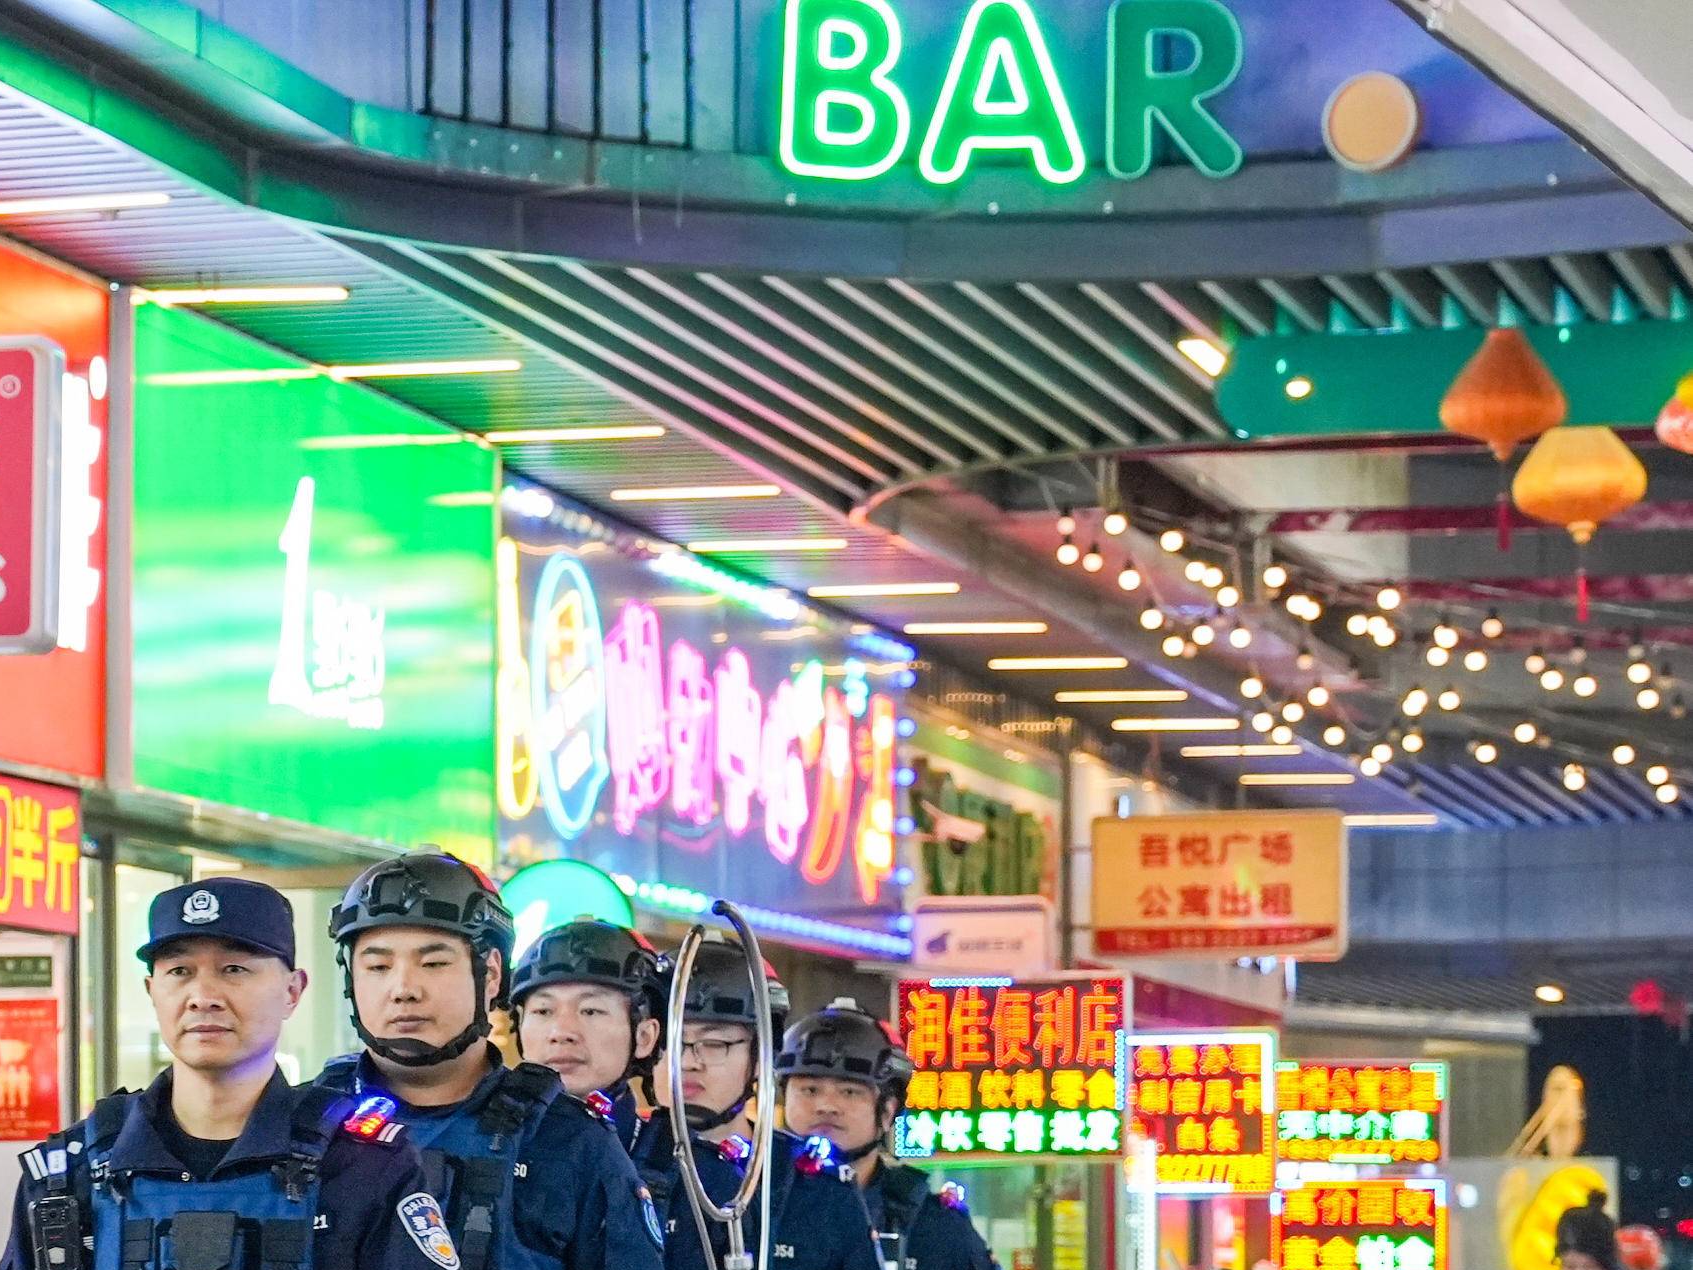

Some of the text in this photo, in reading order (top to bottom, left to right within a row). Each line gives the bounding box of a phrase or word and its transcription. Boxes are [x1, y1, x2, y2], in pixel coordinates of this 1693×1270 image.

[779, 0, 1244, 186] BAR
[1139, 830, 1295, 868] 吾悦广场
[1137, 881, 1293, 918] 公寓出租
[978, 1069, 1045, 1109] 饮料
[1050, 1069, 1117, 1110] 零食
[1281, 1188, 1436, 1227] 高价回收
